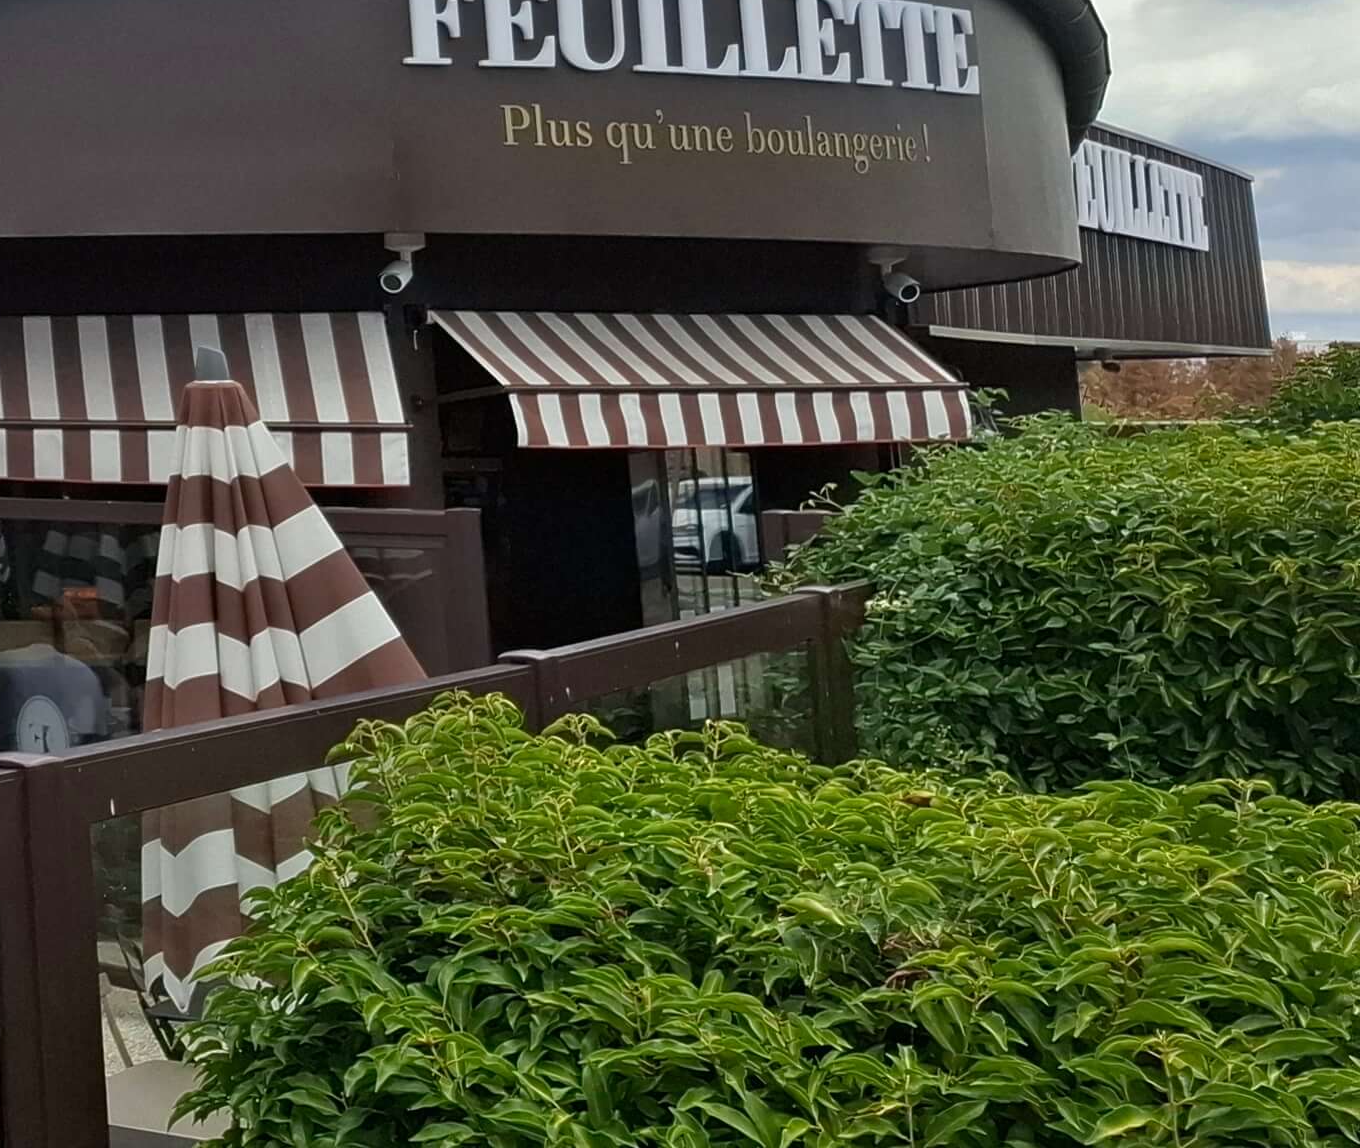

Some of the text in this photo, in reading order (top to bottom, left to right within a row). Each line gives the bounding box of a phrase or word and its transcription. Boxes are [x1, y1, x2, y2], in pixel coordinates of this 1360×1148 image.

[500, 103, 593, 148] Plus
[606, 109, 734, 165] qu'une
[1072, 139, 1209, 251] EUILLETTE
